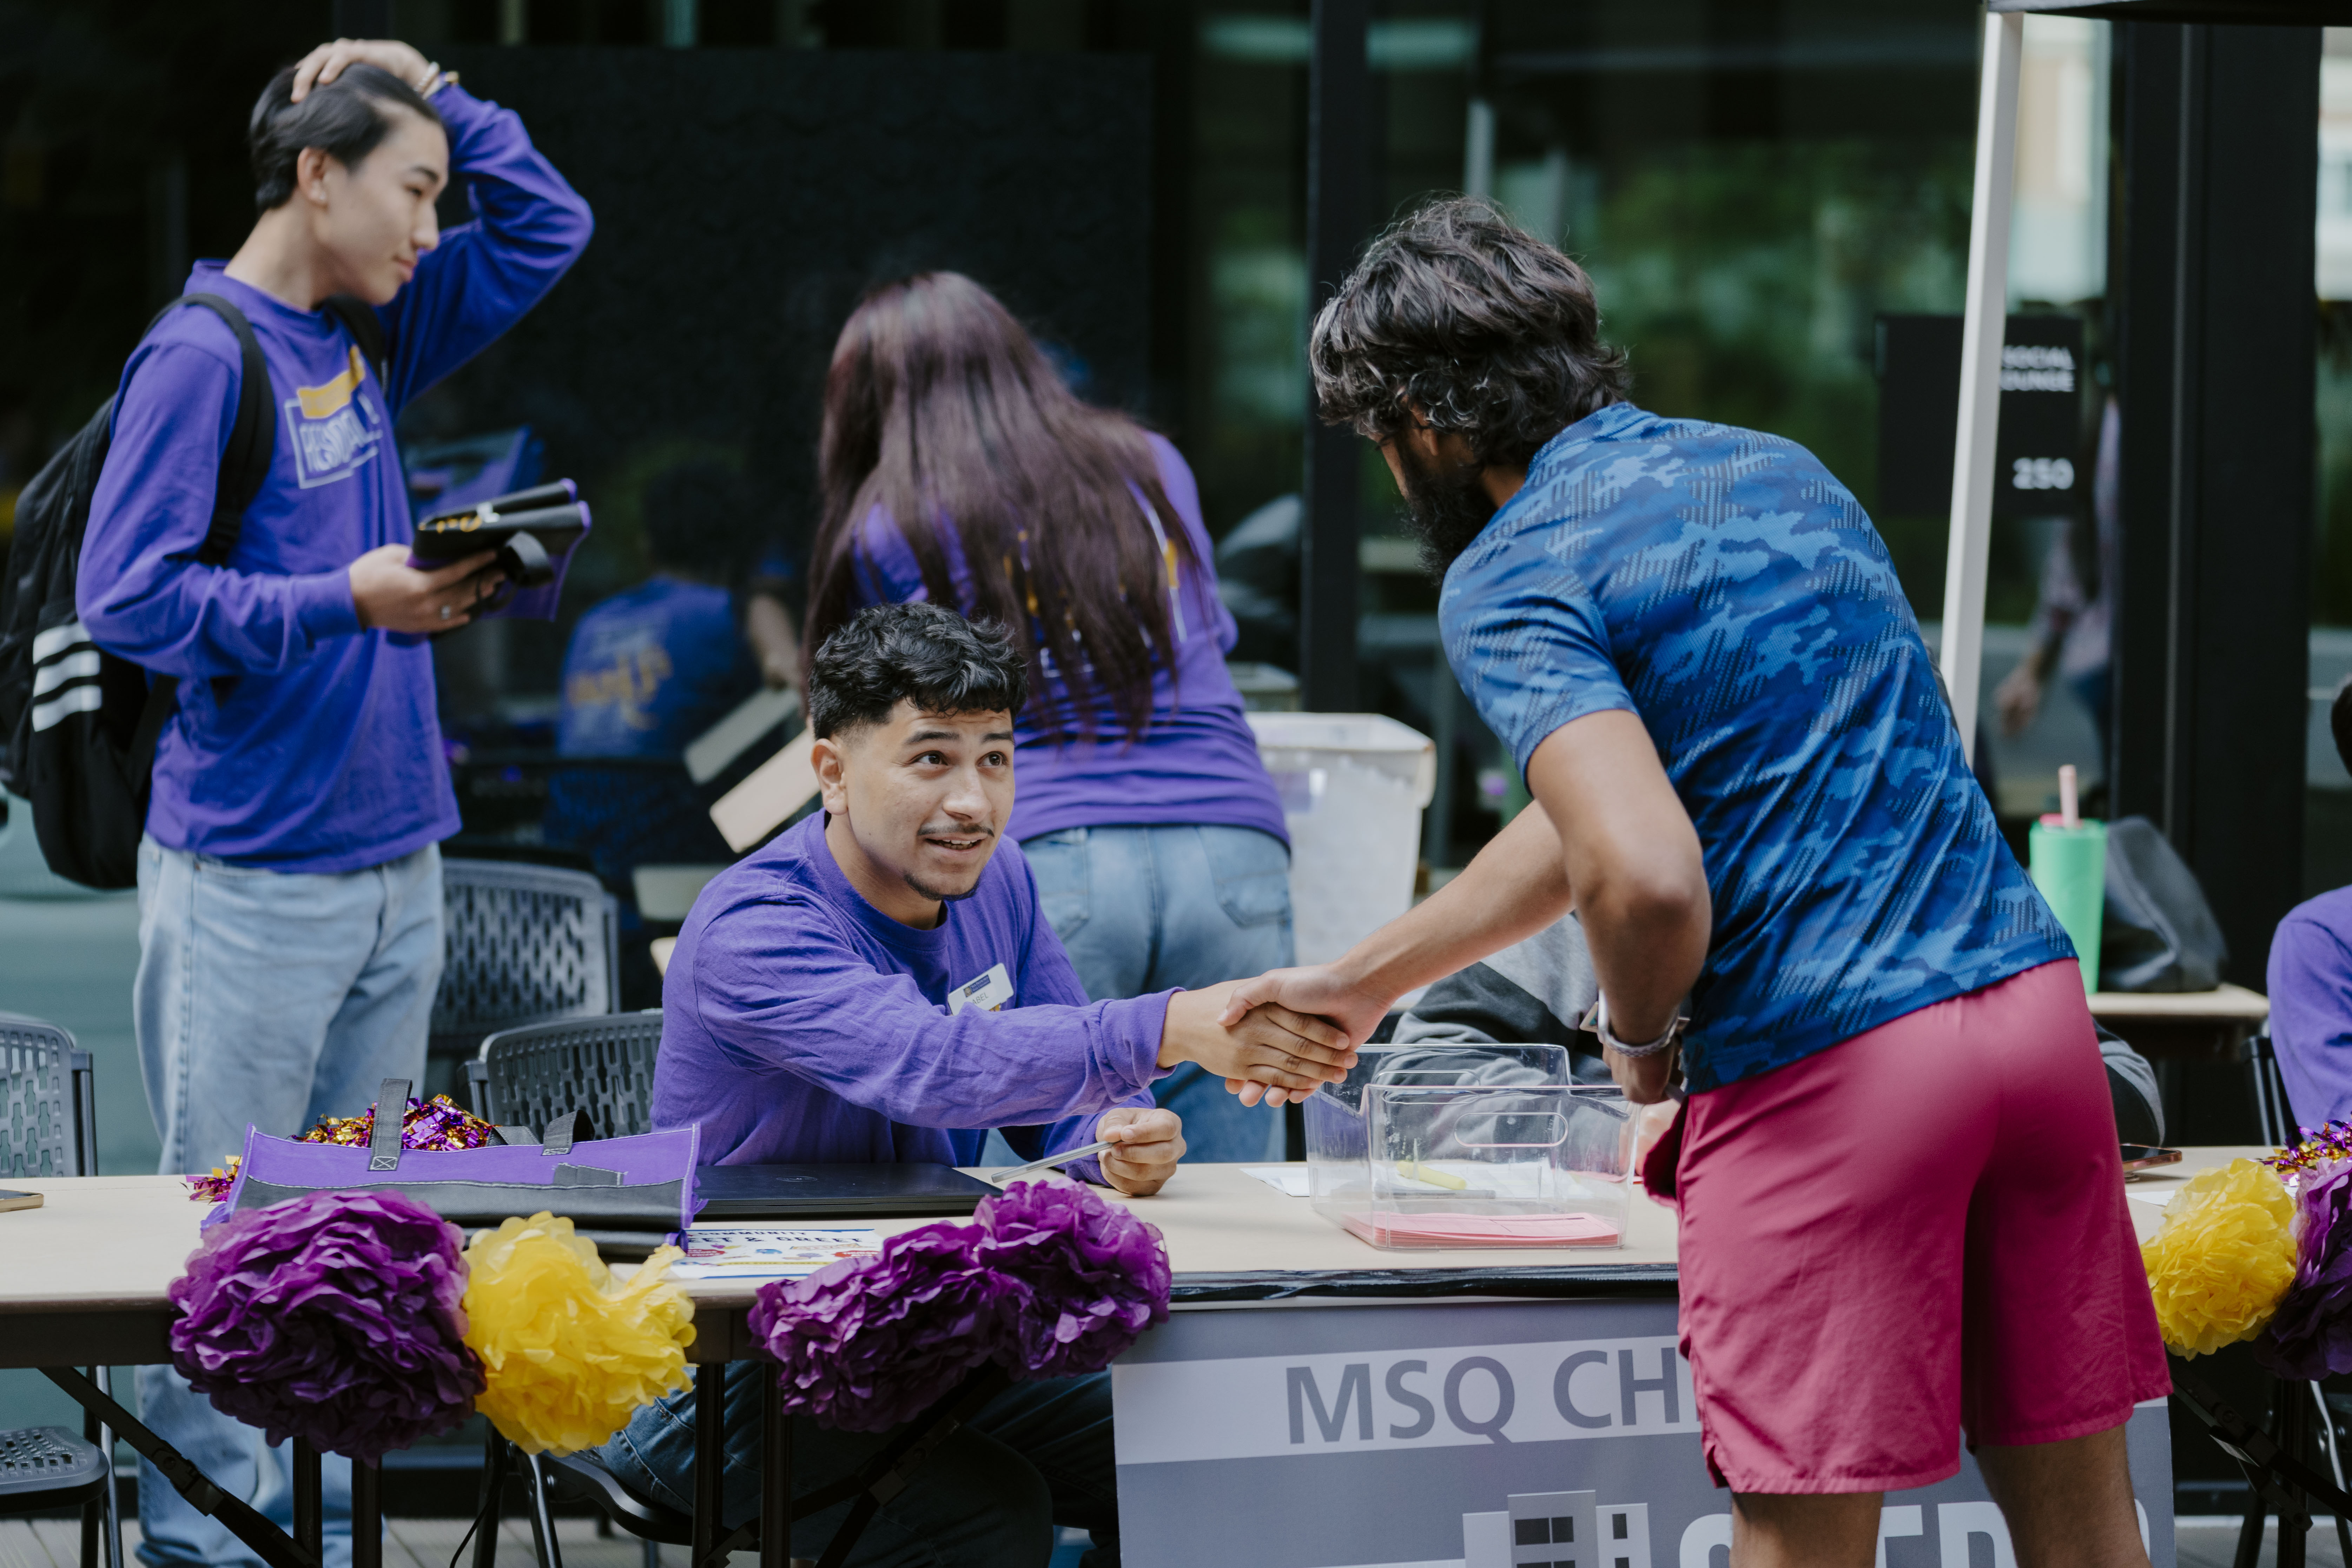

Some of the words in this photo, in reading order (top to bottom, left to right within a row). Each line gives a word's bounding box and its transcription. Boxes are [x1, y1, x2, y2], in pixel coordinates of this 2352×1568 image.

[2000, 370, 2075, 392] OUNGE
[2012, 457, 2074, 490] 250
[972, 993, 989, 1004] ABEL
[1286, 1356, 1515, 1444] MSQ
[1553, 1347, 1700, 1429] CH
